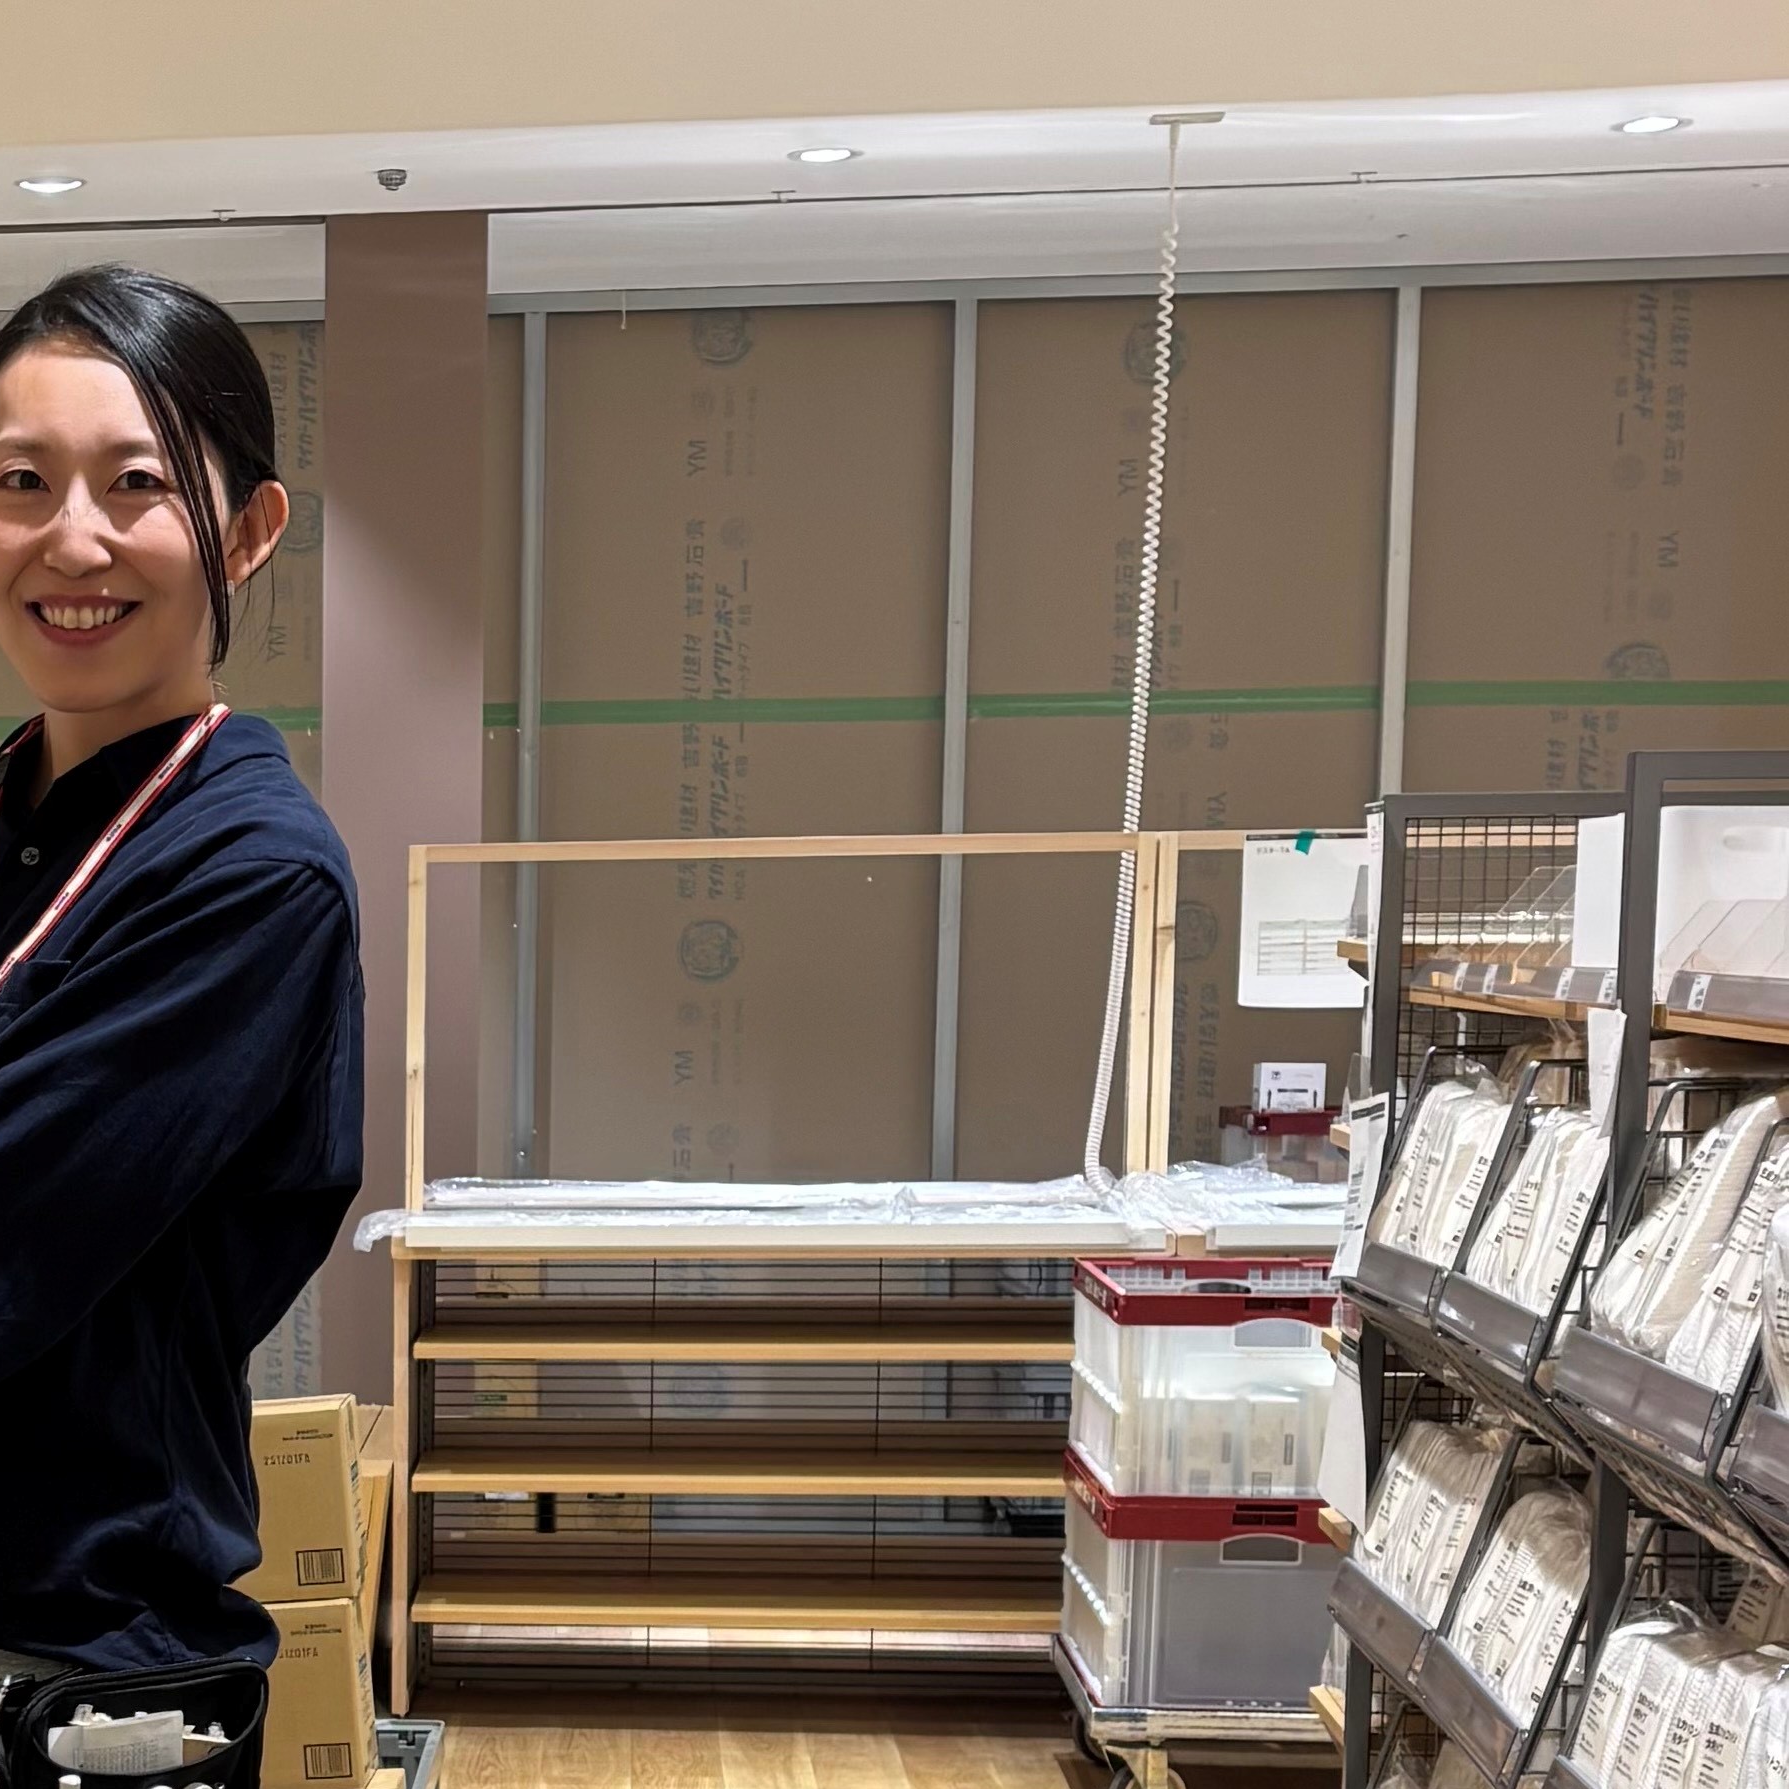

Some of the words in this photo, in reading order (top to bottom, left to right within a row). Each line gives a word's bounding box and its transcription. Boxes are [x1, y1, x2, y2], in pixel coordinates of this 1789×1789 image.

[686, 439, 708, 477] YM
[1117, 459, 1139, 496] YM
[1657, 530, 1680, 568] YM
[673, 1050, 694, 1085] YM
